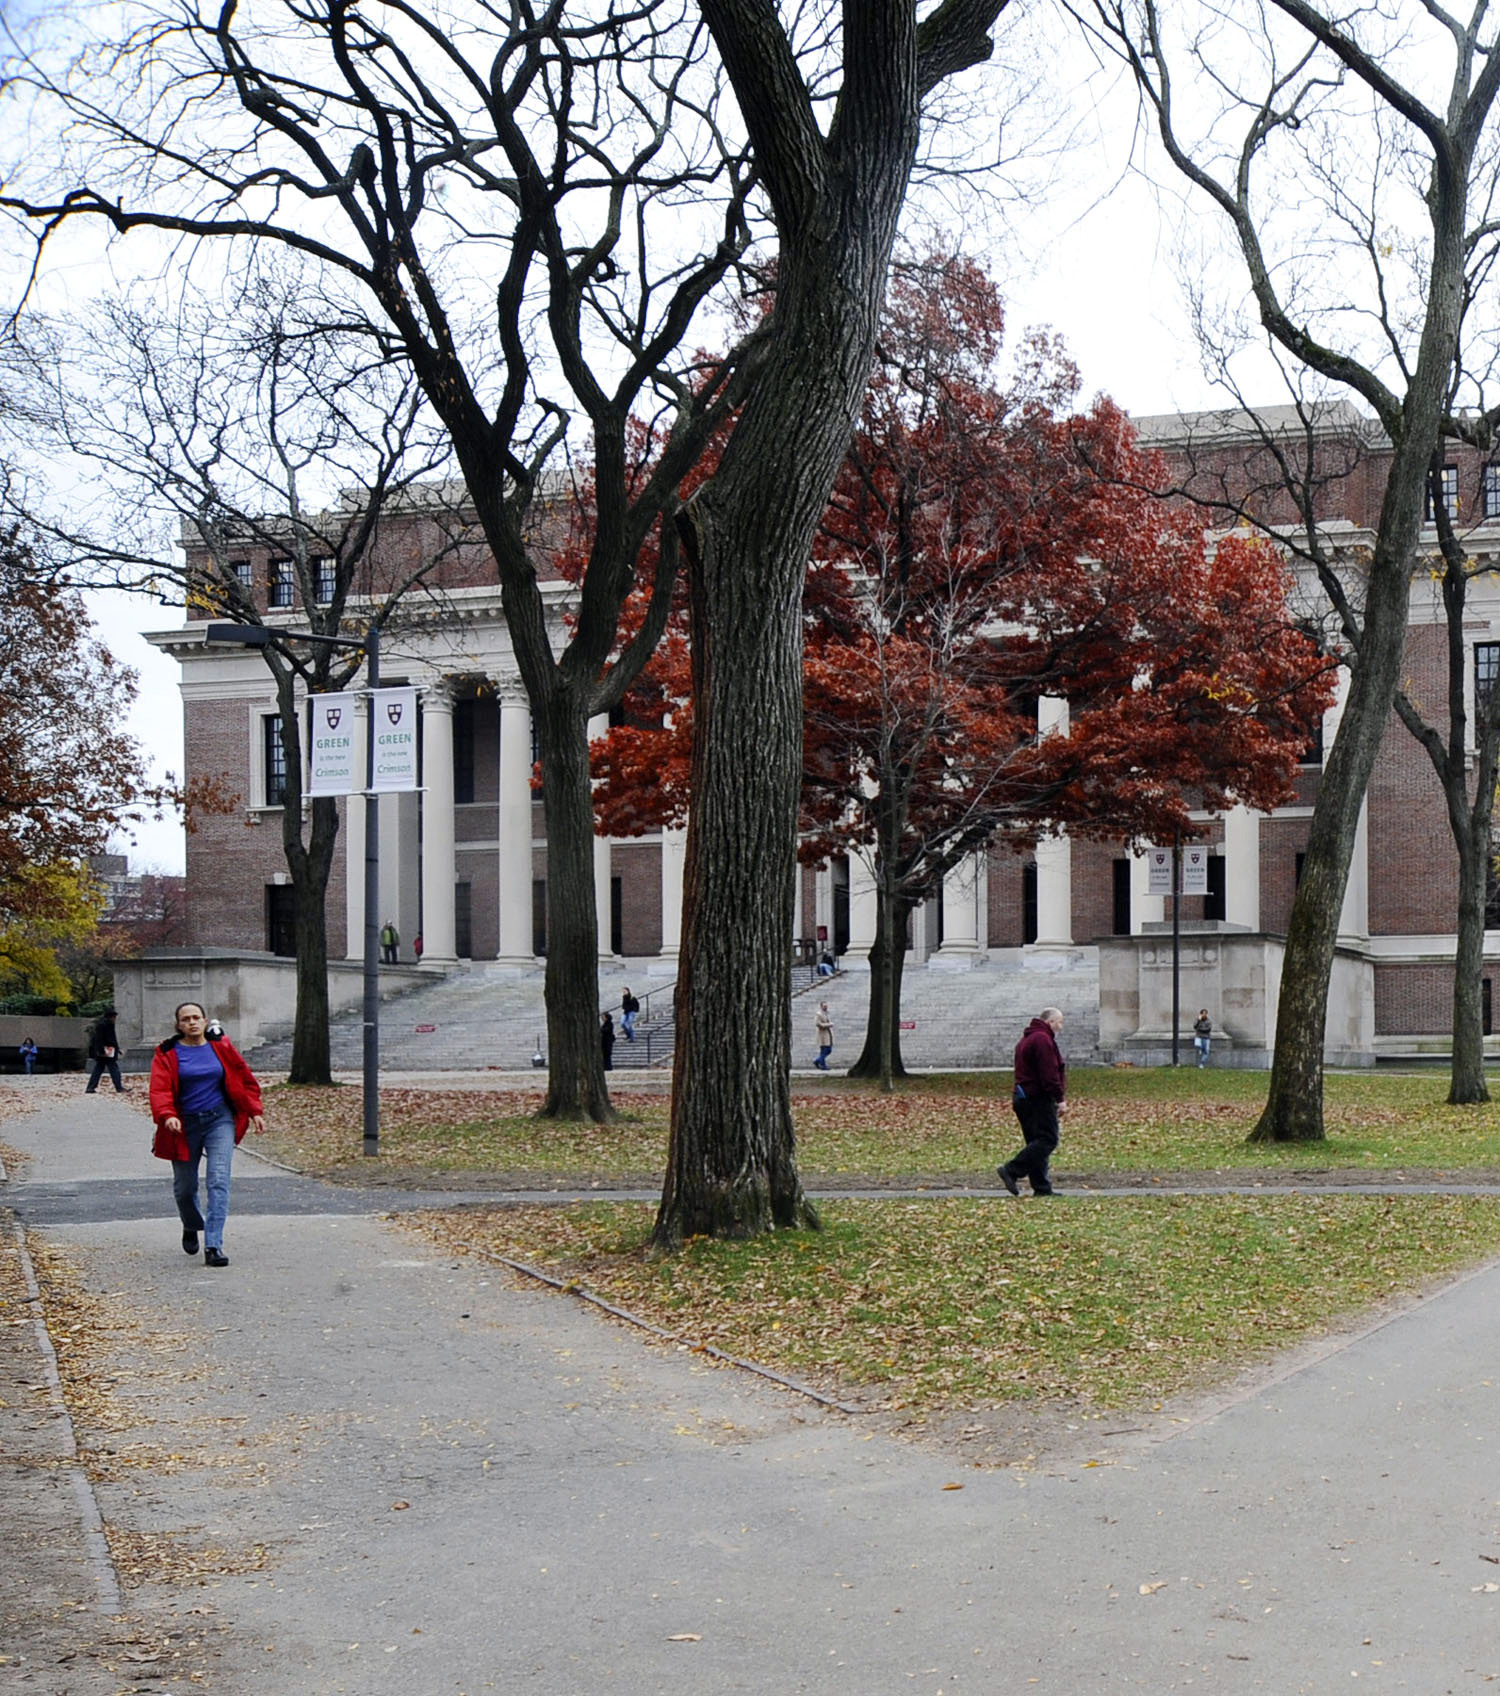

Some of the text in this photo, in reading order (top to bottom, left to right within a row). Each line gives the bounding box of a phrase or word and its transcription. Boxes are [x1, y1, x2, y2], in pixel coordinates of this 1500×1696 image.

[316, 737, 350, 749] GREEN
[378, 733, 412, 745] GREEN
[315, 767, 349, 777] Crimson
[377, 764, 411, 774] Crimson
